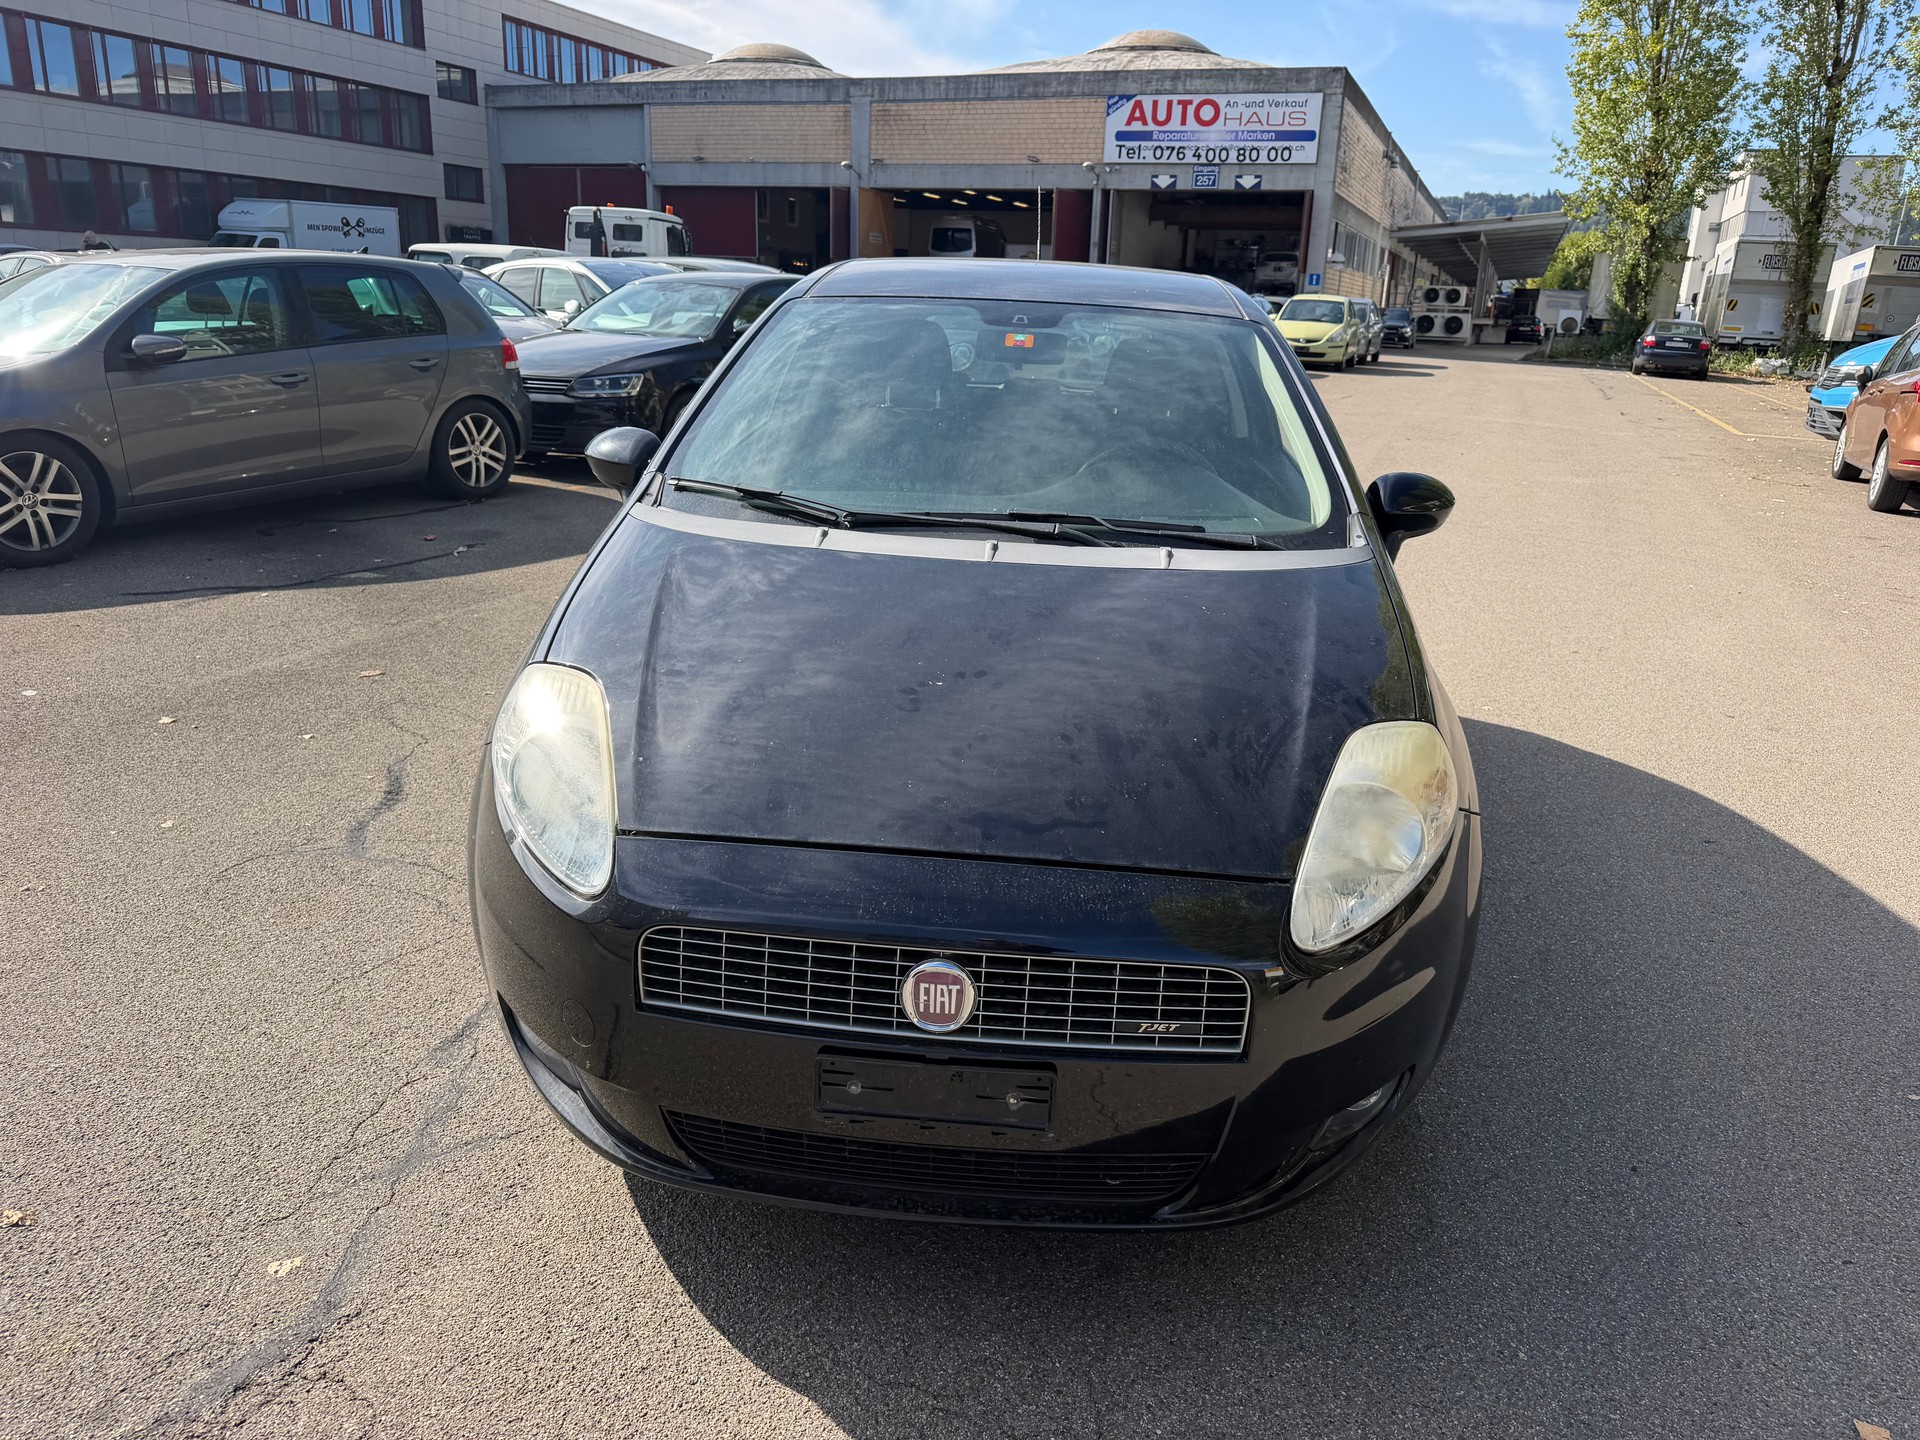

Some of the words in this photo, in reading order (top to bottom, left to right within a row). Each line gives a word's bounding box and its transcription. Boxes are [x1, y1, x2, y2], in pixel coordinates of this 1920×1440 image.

[1225, 100, 1239, 108] An
[1268, 99, 1309, 108] Verkauf
[1125, 98, 1221, 127] AUTO
[1223, 111, 1308, 127] HAUS
[1237, 132, 1276, 140] Marken
[1115, 144, 1147, 160] Tel.
[1153, 145, 1187, 161] 076
[1192, 147, 1231, 163] 400
[1236, 147, 1261, 163] 80
[1266, 146, 1293, 162] 00
[1196, 175, 1215, 186] 257
[919, 983, 960, 1015] FIAT
